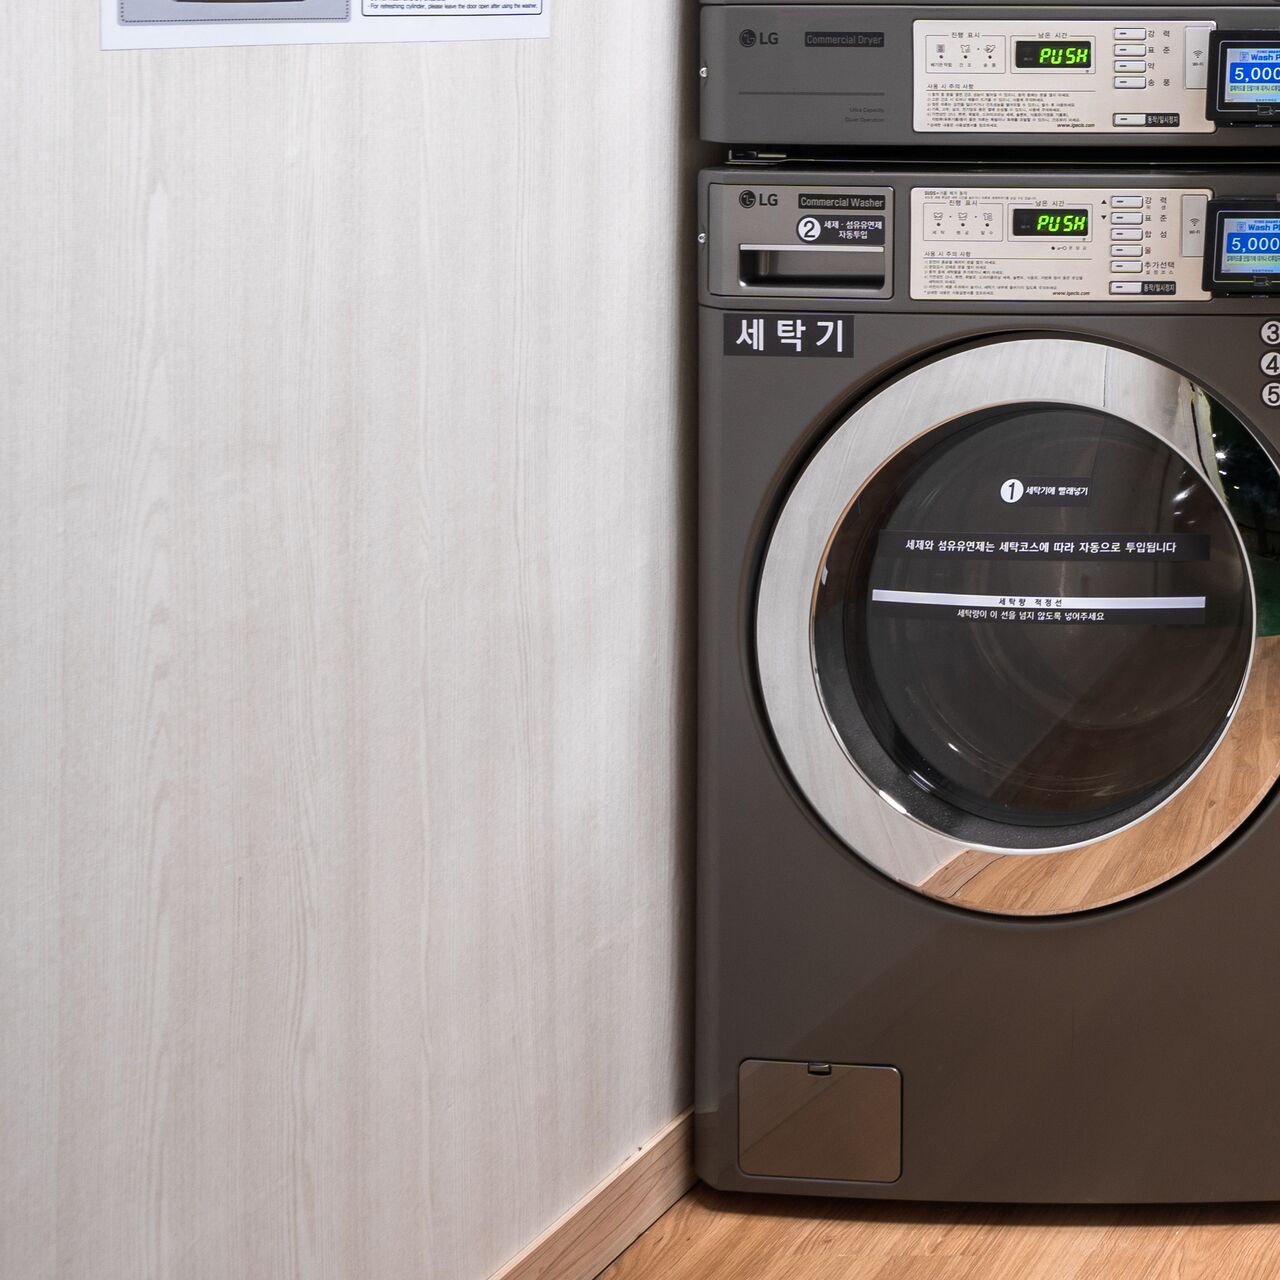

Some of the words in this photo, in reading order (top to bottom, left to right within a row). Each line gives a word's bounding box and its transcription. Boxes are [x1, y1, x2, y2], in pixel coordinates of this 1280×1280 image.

[807, 35, 856, 45] Commercial
[857, 35, 883, 47] Dryer
[1039, 48, 1089, 65] PUSH
[800, 197, 849, 207] Commercial
[851, 197, 884, 208] Washer
[1037, 215, 1086, 232] PUSH
[1248, 223, 1270, 231] Wash
[736, 319, 843, 352] 세탁기
[1025, 486, 1056, 496] 세탁기에
[1058, 486, 1088, 496] 빨래넣기
[905, 539, 934, 551] 세제와
[938, 539, 995, 553] 섬유유연제는
[999, 540, 1049, 553] 세탁코스에
[1054, 541, 1075, 553] 따라
[1079, 541, 1120, 553] 자동으로
[1125, 541, 1177, 553] 투입됩니다
[957, 609, 987, 619] 세탁량이
[990, 609, 998, 619] 이
[1000, 610, 1016, 620] 선을
[1019, 610, 1035, 620] 넘지
[1037, 611, 1061, 621] 않도록
[1064, 611, 1104, 621] 넣어주세요
